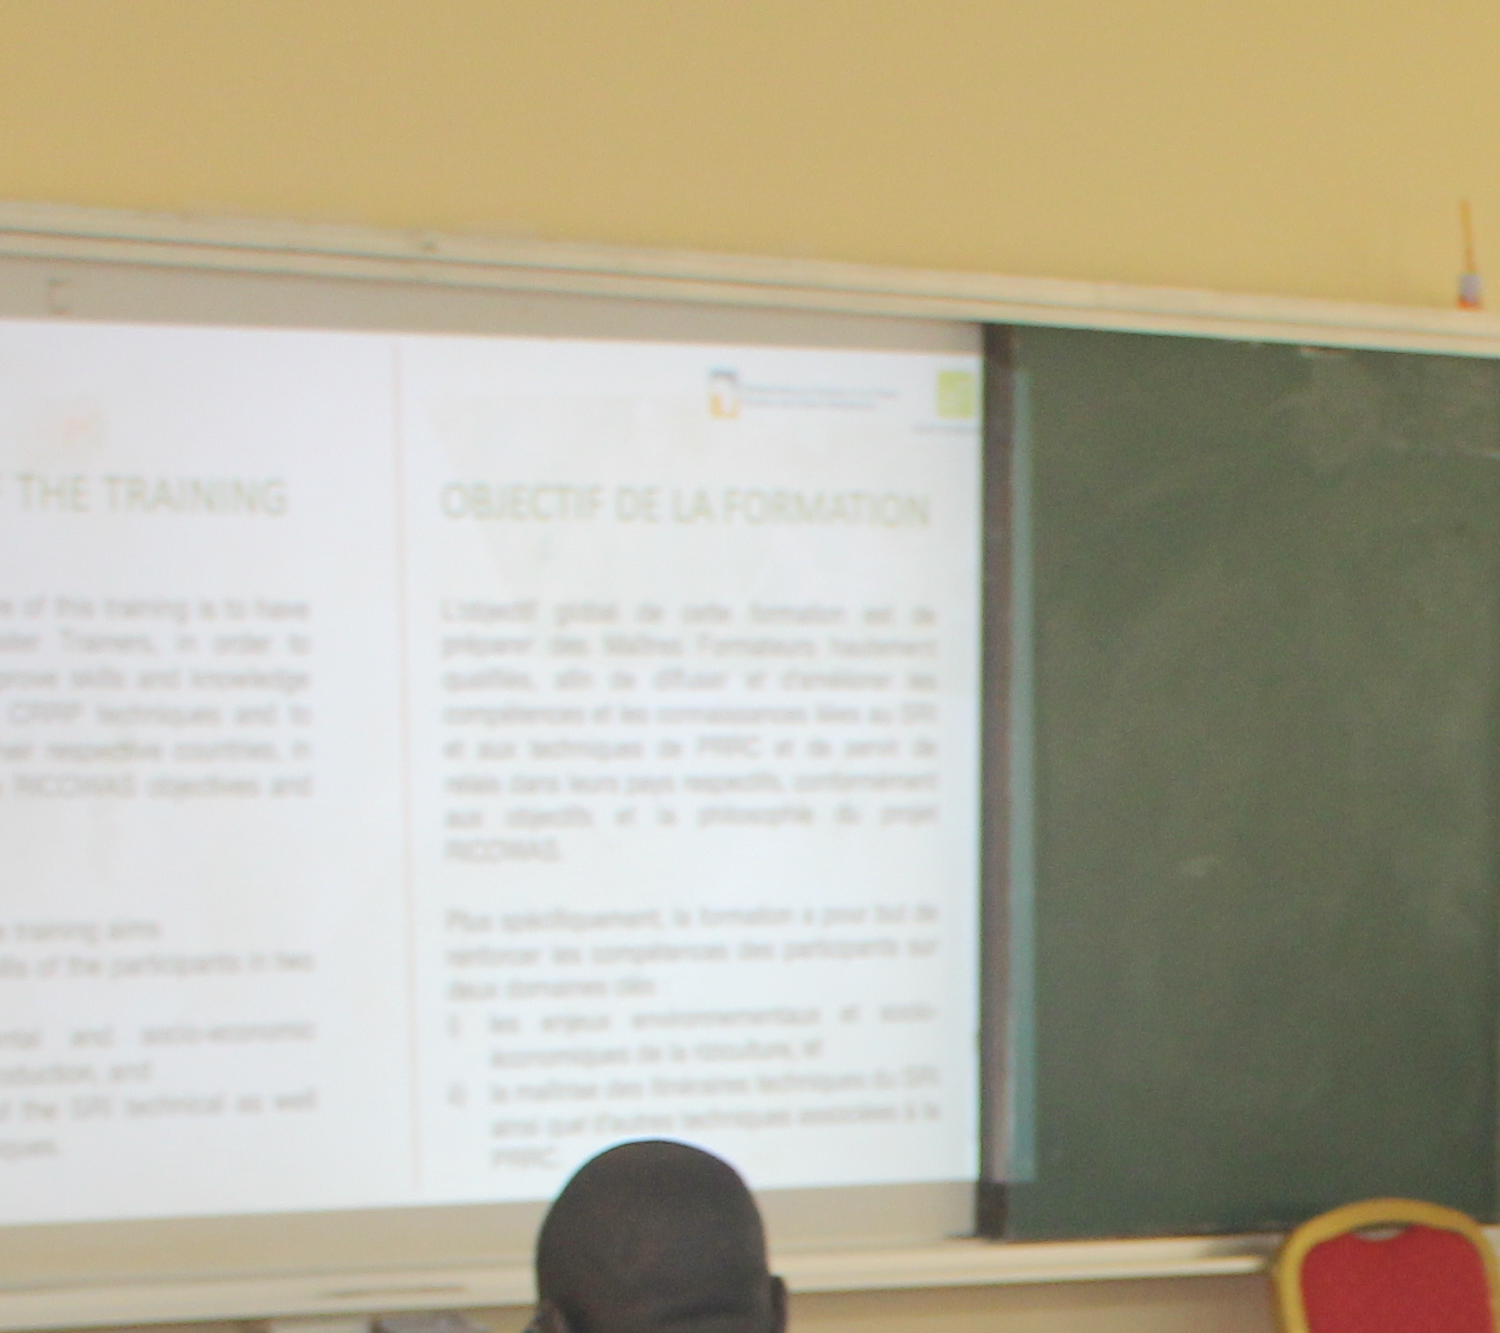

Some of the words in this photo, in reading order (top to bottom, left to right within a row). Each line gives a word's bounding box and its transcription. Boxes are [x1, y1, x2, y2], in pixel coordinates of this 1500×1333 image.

[19, 475, 91, 514] THE
[102, 475, 289, 518] TRAINING
[441, 482, 603, 525] OBJECTIF
[615, 486, 659, 526] DE
[673, 488, 720, 527] LA
[725, 486, 931, 530] FORMATION
